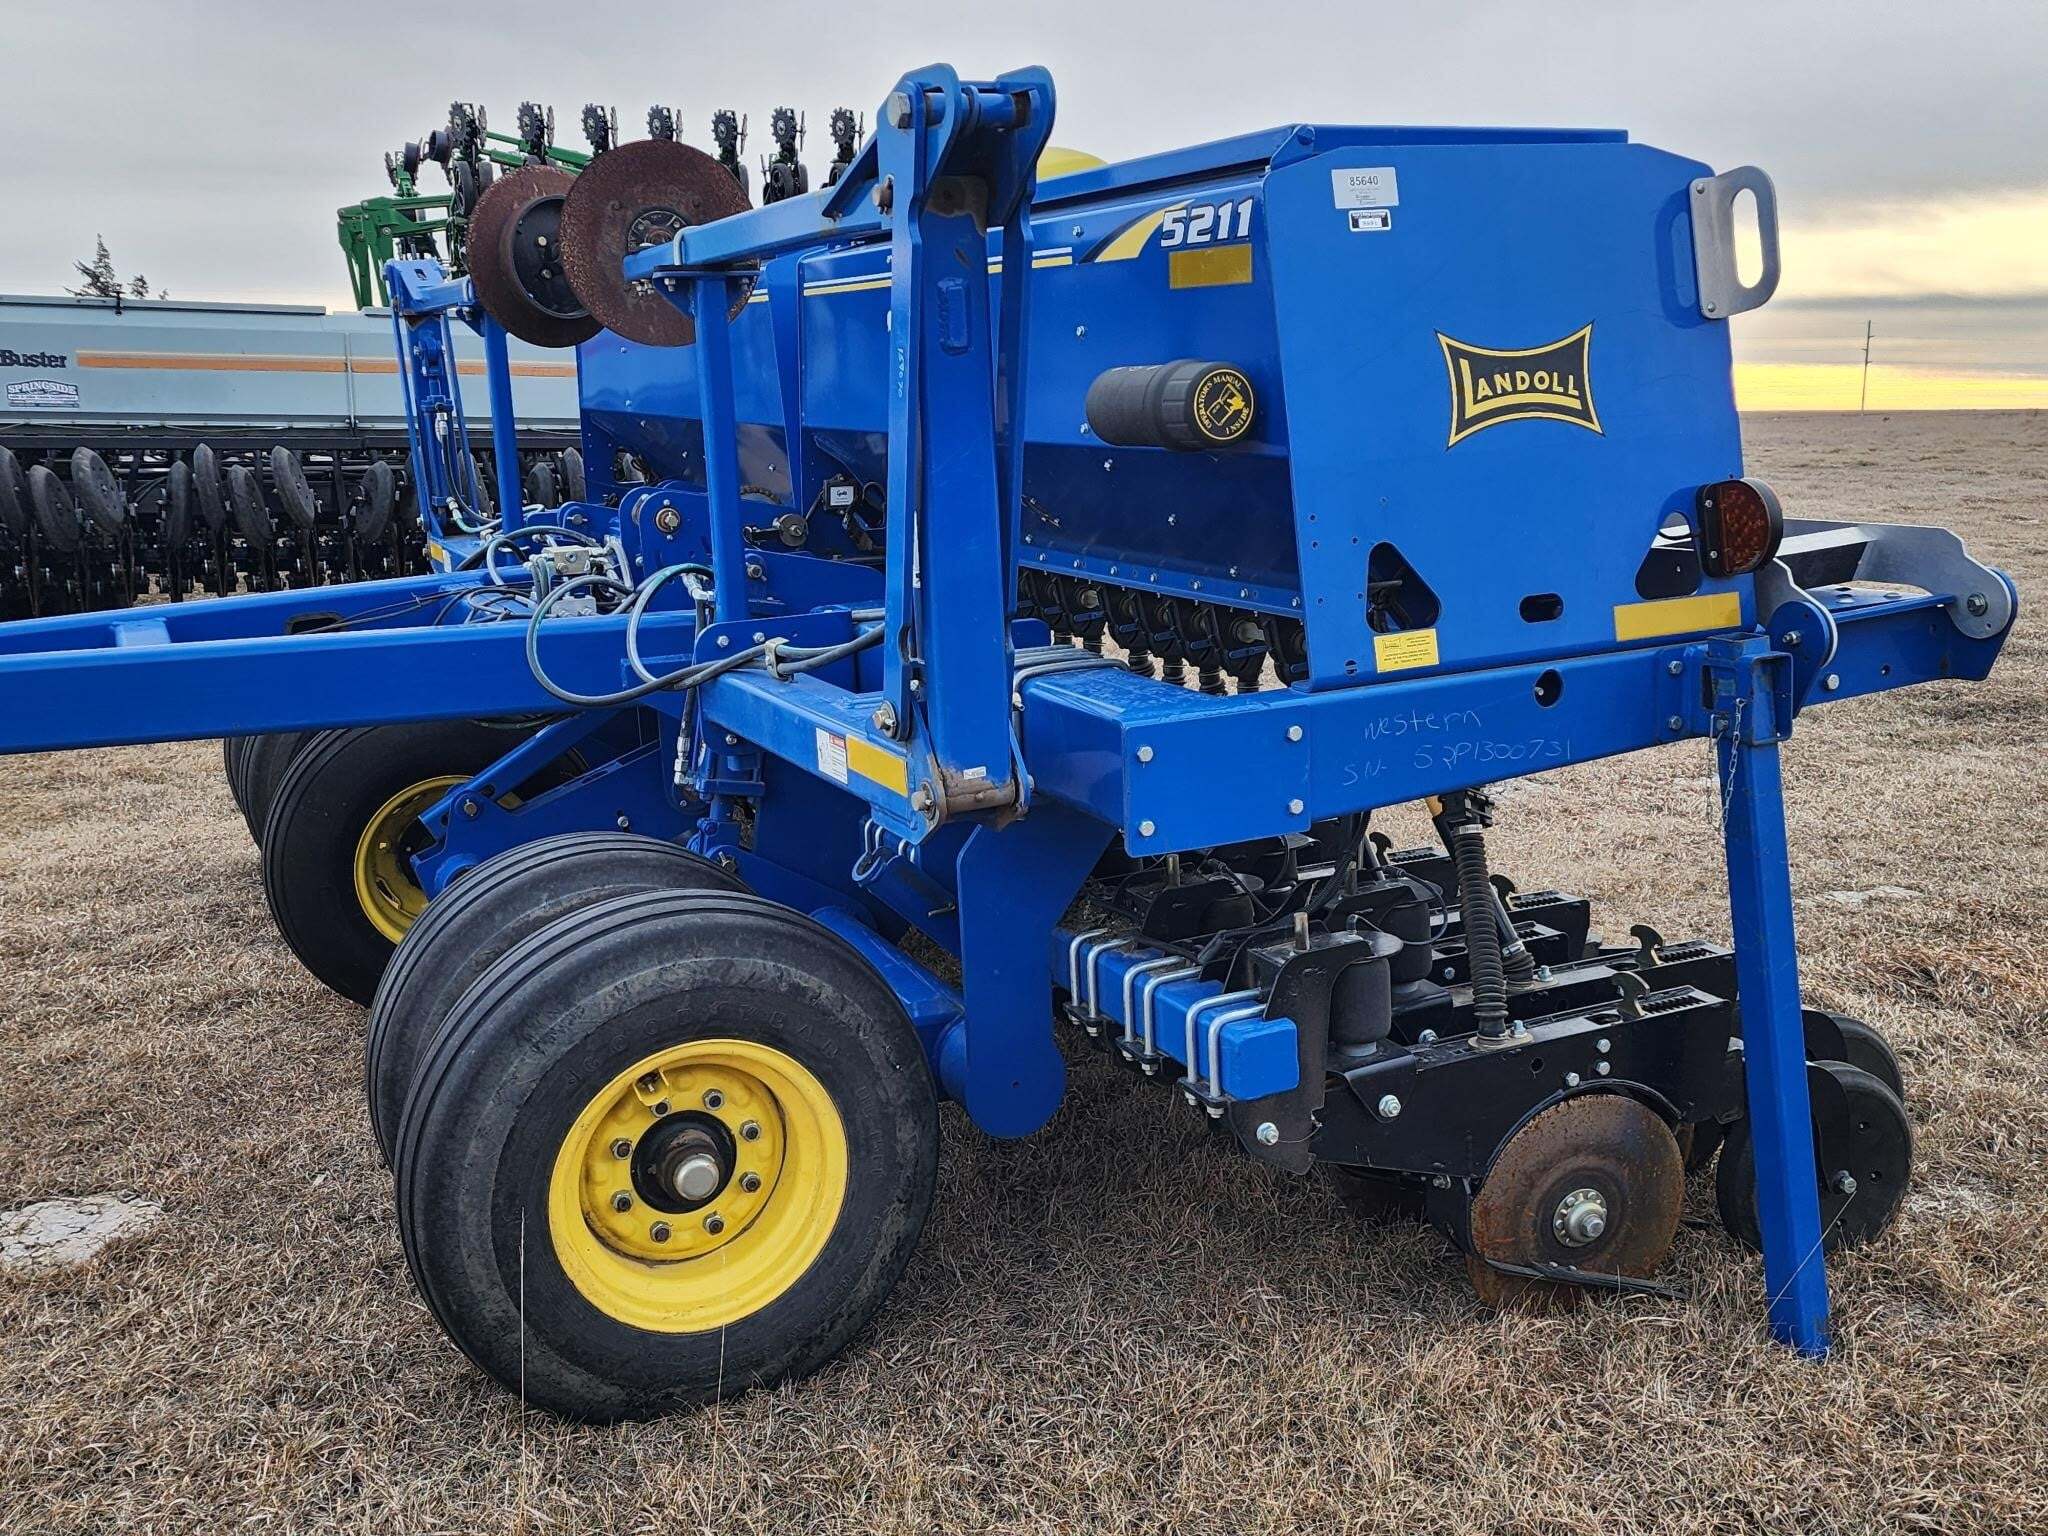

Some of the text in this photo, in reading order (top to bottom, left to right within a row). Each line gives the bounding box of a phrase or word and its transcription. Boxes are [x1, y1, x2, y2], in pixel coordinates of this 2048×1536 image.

[1349, 175, 1379, 187] 85640
[1161, 198, 1254, 247] 5211
[7, 381, 77, 394] SPRINGSIDE
[1459, 358, 1583, 420] LANDOLL
